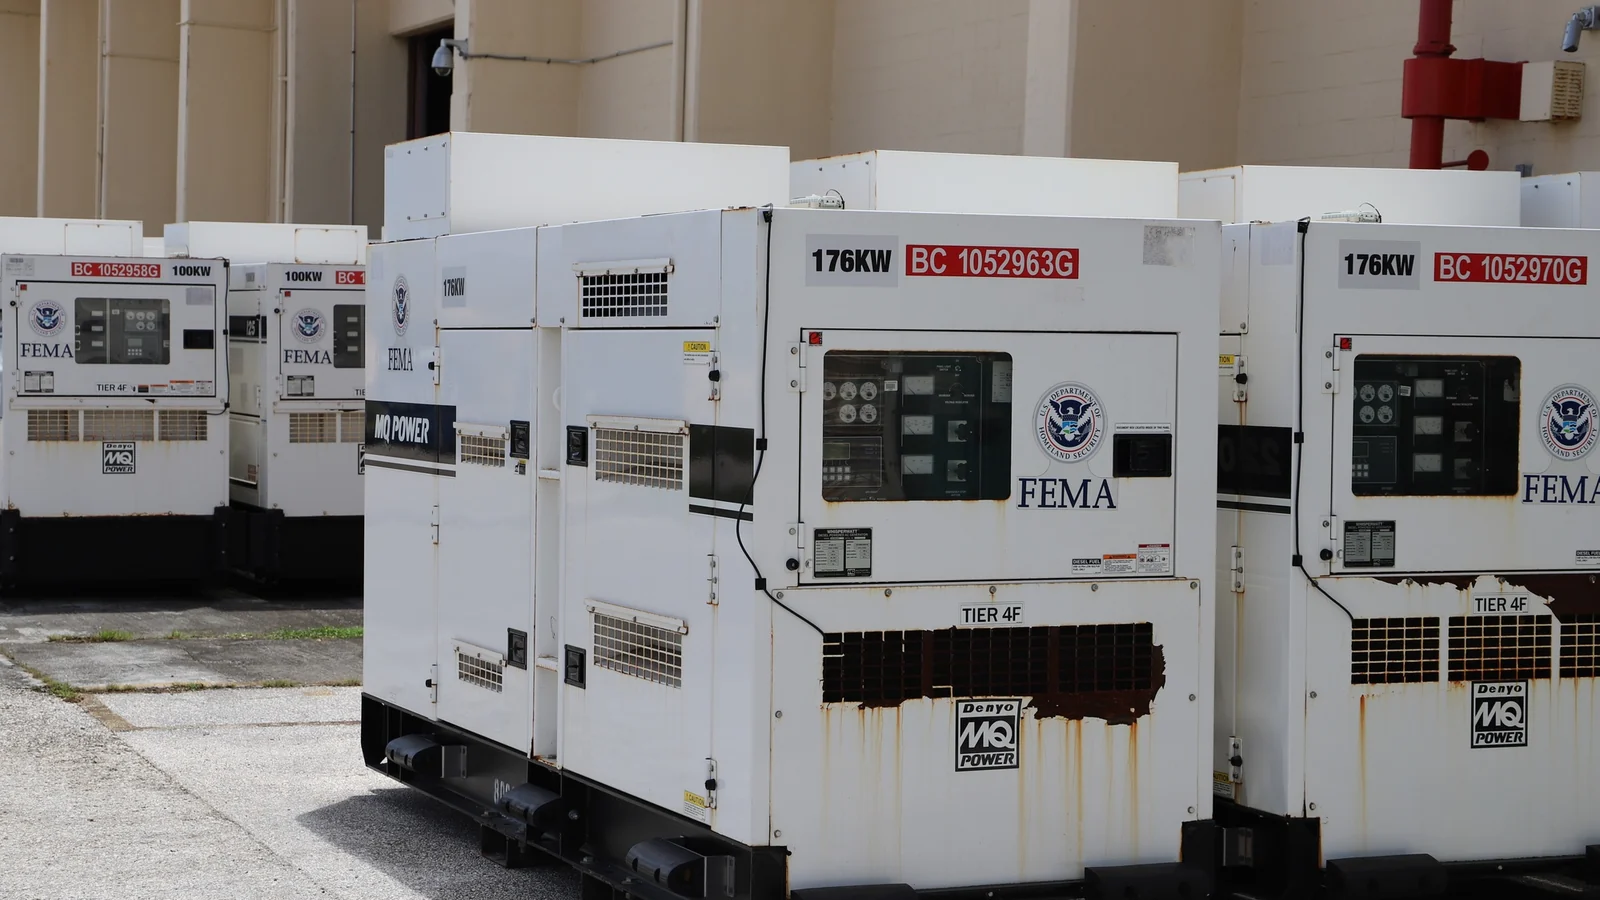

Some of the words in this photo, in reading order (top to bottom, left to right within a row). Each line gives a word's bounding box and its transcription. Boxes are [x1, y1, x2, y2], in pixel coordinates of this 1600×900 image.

[812, 249, 892, 273] 176KW
[911, 247, 948, 274] BC
[958, 248, 1073, 276] 1052963G
[1344, 253, 1415, 276] 176KW
[1439, 254, 1472, 280] BC
[1481, 255, 1582, 283] 1052970G
[74, 264, 93, 276] BC
[98, 264, 159, 277] 1052958G
[172, 265, 211, 276] 100KW
[284, 271, 322, 281] 100KW
[338, 272, 355, 283] BC
[443, 277, 465, 297] 176KW
[20, 342, 74, 358] FEMA
[283, 349, 332, 364] FEMA
[387, 347, 413, 371] FEMA
[97, 384, 115, 392] TIER
[117, 384, 127, 392] 4F
[1040, 403, 1050, 417] U.S.
[1050, 387, 1097, 407] DEPARTMENT
[1094, 408, 1101, 418] OF
[1553, 389, 1594, 409] DEPARTMENT
[1591, 410, 1598, 418] OF
[374, 414, 391, 444] MQ
[392, 415, 430, 444] POWER
[1039, 426, 1070, 459] HOMELAND
[1073, 427, 1101, 459] SECURITY
[1541, 426, 1570, 457] HOMELAND
[1572, 427, 1597, 457] SECURITY
[105, 452, 134, 465] MQ
[1017, 478, 1117, 509] FEMA
[1475, 598, 1507, 612] TIER
[1510, 597, 1527, 611] 4F
[962, 607, 998, 623] TIER
[1002, 606, 1022, 622] 4F
[1477, 684, 1522, 695] Denyo
[962, 703, 1014, 714] Denyo
[1475, 700, 1524, 728] MQ
[960, 720, 1015, 749] MQ
[1475, 731, 1524, 744] POWER
[960, 753, 1015, 767] POWER
